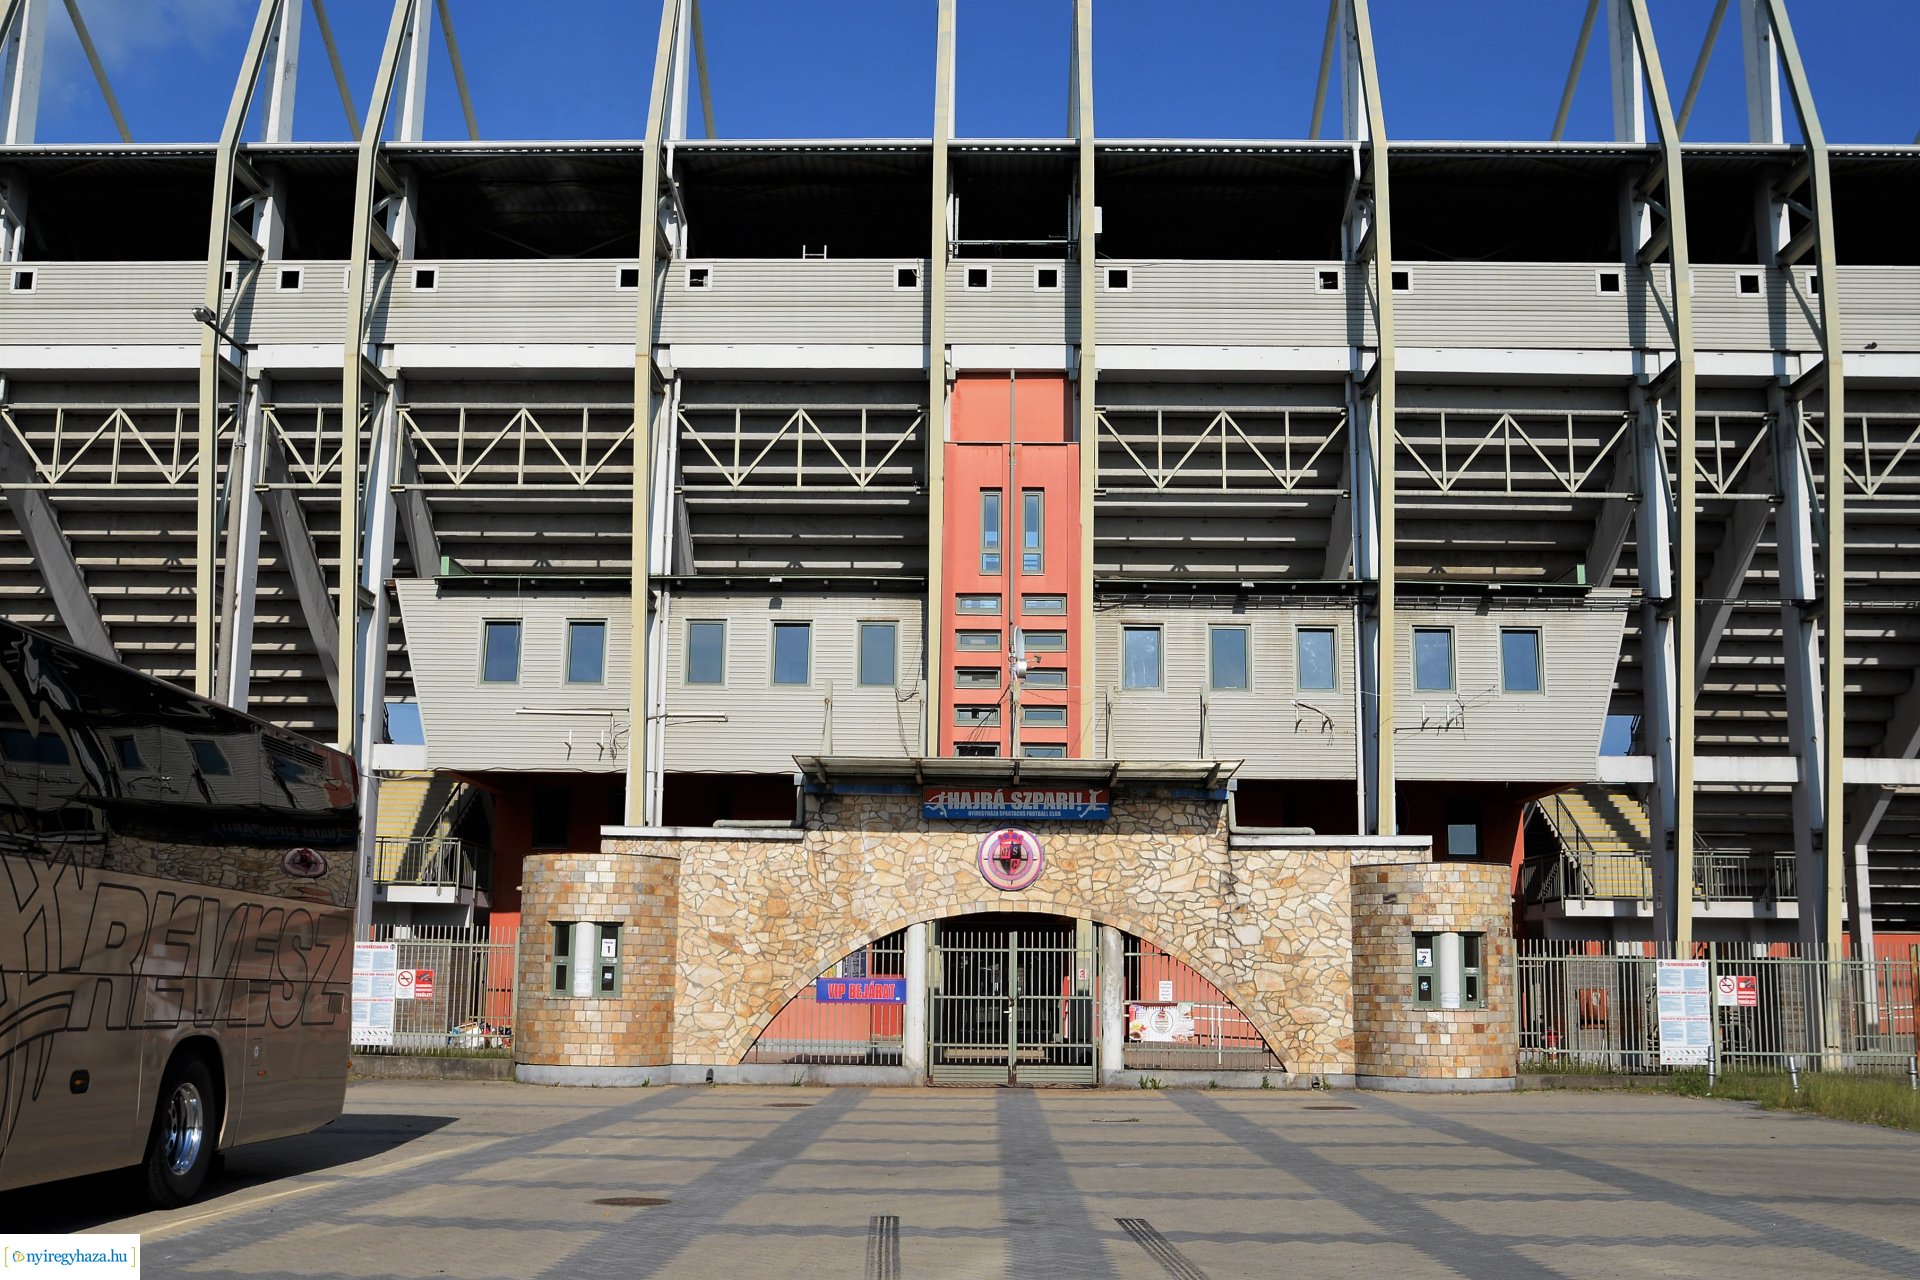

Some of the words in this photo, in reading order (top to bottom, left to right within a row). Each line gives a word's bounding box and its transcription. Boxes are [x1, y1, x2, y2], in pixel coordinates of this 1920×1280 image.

[948, 788, 1005, 810] HAJRÁ
[1010, 791, 1082, 811] SZPARI!
[1422, 955, 1426, 964] 2
[828, 983, 846, 999] VIP
[848, 981, 896, 999] BEJÁRAT
